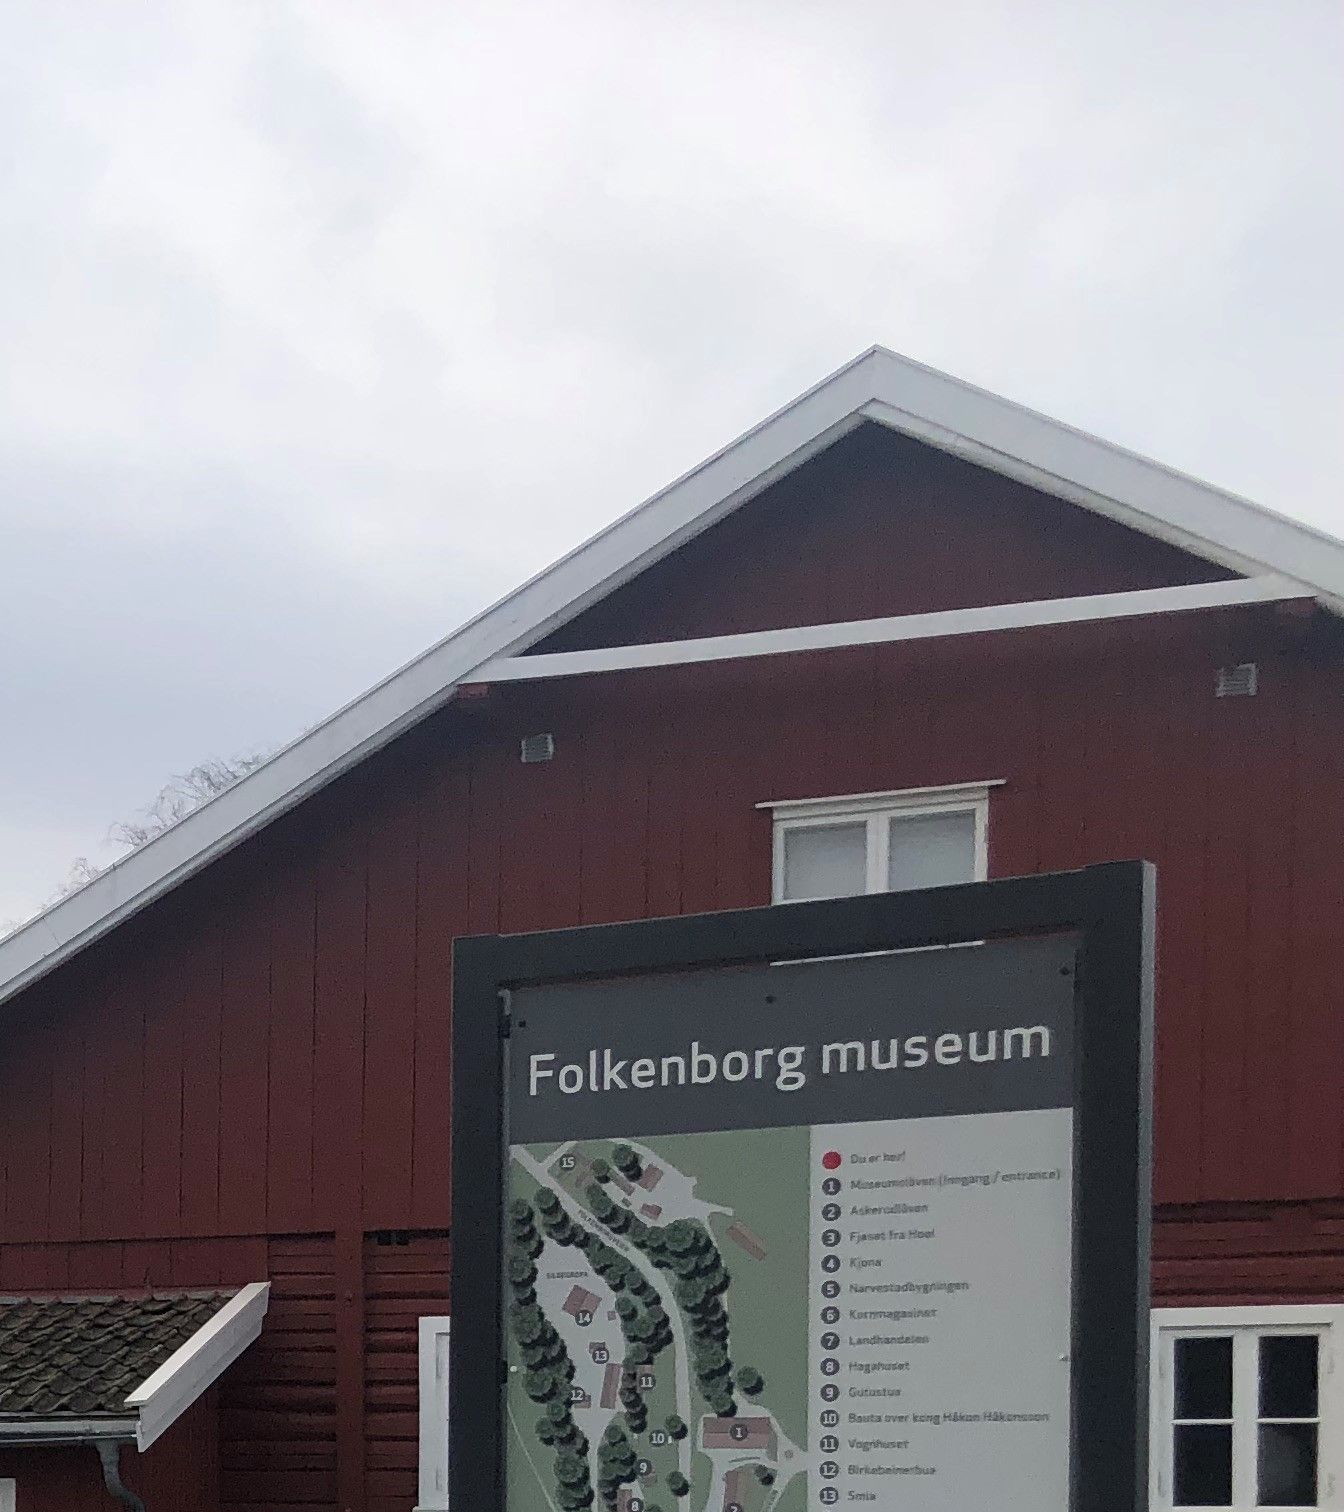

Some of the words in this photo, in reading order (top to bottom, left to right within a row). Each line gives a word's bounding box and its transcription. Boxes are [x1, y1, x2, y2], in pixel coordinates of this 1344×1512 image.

[529, 1041, 808, 1095] Folkenborg
[821, 1024, 1051, 1074] museum
[850, 1153, 867, 1165] Du
[868, 1153, 882, 1164] er
[1001, 1168, 1061, 1182] entrance)
[889, 1229, 906, 1241] fra
[849, 1307, 937, 1322] Kornmagasinet
[848, 1335, 930, 1346] Landhandelen
[848, 1412, 882, 1424] Bauta
[884, 1413, 909, 1424] over
[912, 1411, 941, 1426] kong
[847, 1490, 877, 1502] Smia
